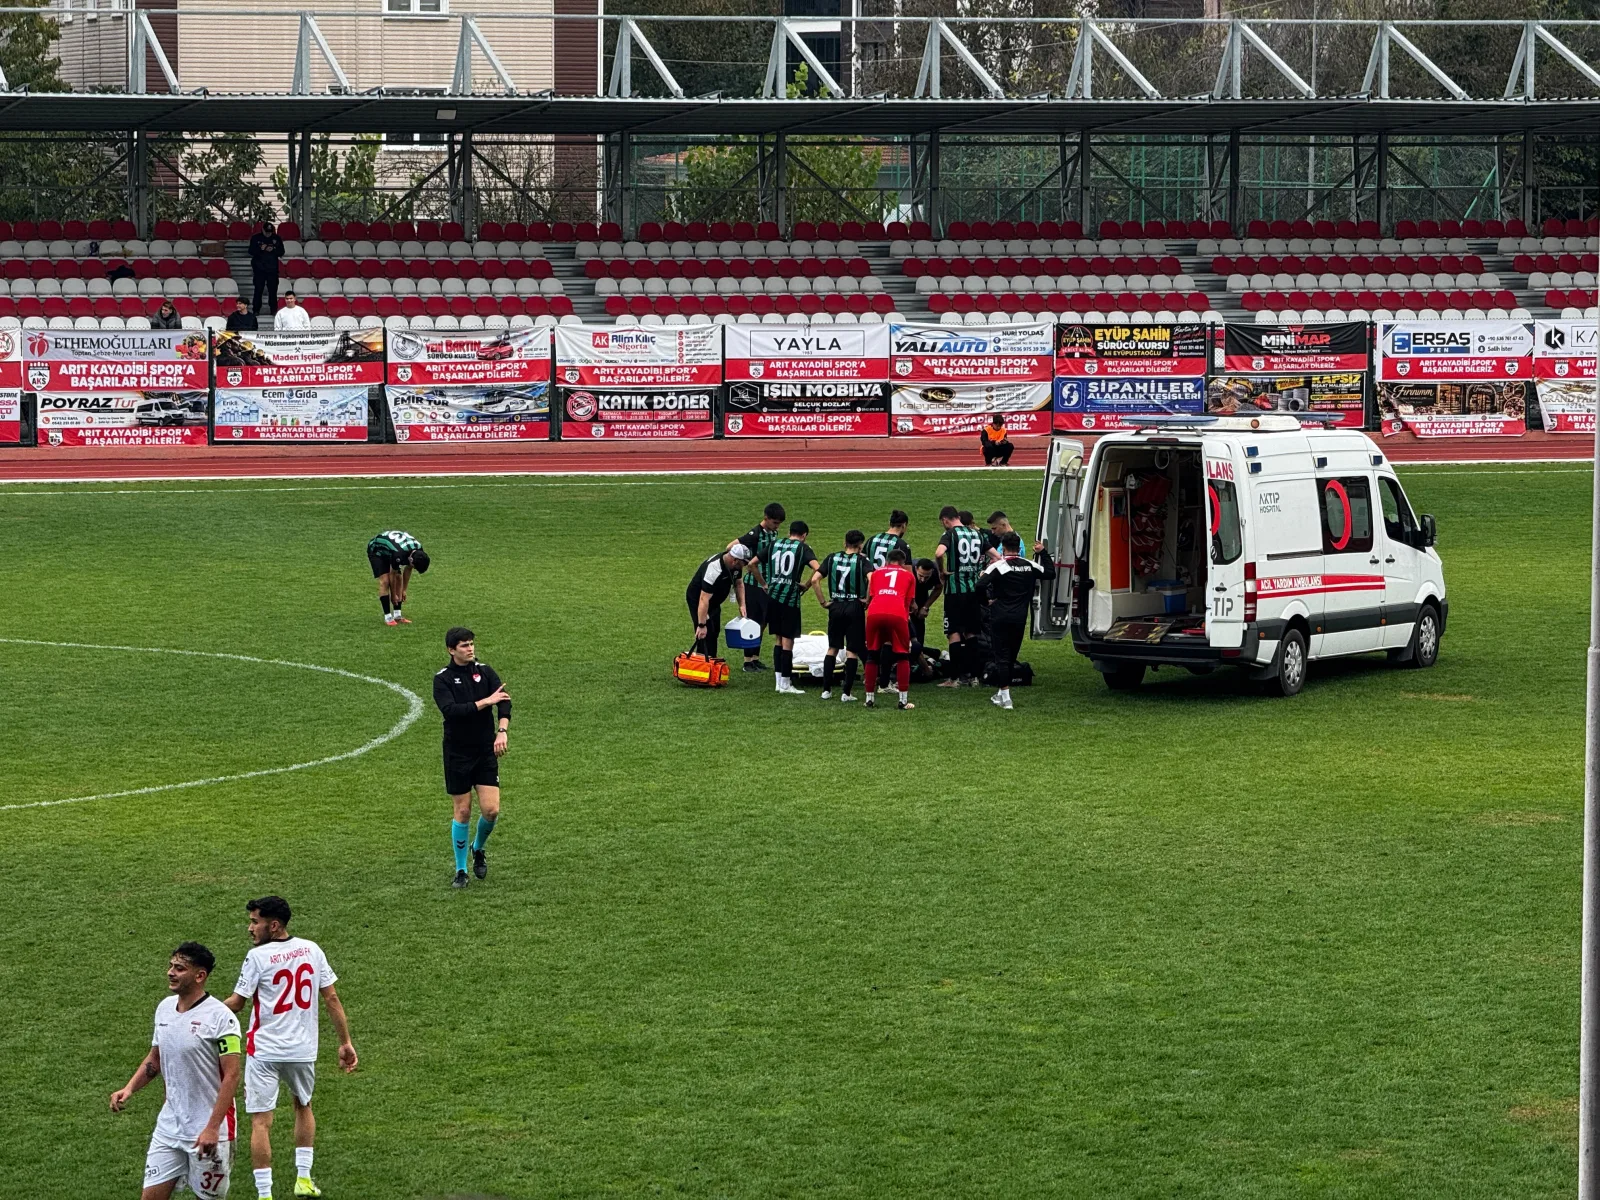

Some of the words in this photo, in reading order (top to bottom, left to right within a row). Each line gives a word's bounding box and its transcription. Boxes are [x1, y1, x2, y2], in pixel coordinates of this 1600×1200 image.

[279, 332, 310, 340] Taşkömürü
[594, 335, 608, 346] AK
[635, 334, 656, 345] Kılıç
[1095, 326, 1130, 341] EYÜP
[1133, 325, 1170, 343] ŞAHİN
[1412, 333, 1470, 347] ERSAŞ
[54, 335, 172, 350] ETHEMOĞULLARI
[264, 339, 298, 347] Müessesesi
[773, 337, 842, 351] YAYLA
[895, 341, 938, 353] YALI
[938, 341, 988, 353] AUTO
[1097, 340, 1136, 350] SÜRÜCÜ
[1138, 342, 1170, 350] KURSU
[301, 352, 326, 361] İşçileri
[923, 359, 947, 367] ARIT
[949, 357, 998, 366] KAYADİBİ
[1438, 358, 1471, 366] KAYADİBİ
[59, 364, 88, 375] ARIT
[90, 362, 148, 375] KAYADİBİ
[150, 364, 195, 375] SPOR'A
[255, 367, 279, 376] ARIT
[280, 364, 325, 375] KAYADİBİ
[425, 364, 447, 372] ARIT
[448, 362, 493, 371] KAYADİBİ
[617, 365, 662, 375] KAYADİBİ
[769, 361, 789, 369] ARIT
[791, 359, 833, 369] KAYADİBİ
[1422, 366, 1465, 374] BAŞARILAR
[1467, 365, 1495, 373] DİLERİZ.
[263, 375, 316, 384] BAŞARILAR
[319, 371, 357, 381] DİLERİZ.
[432, 372, 485, 382] BAŞARILAR
[486, 370, 523, 379] DİLERİZ.
[776, 369, 824, 379] BAŞARILAR
[826, 368, 861, 377] DİLERİZ.
[933, 367, 990, 377] BAŞARILAR
[993, 366, 1032, 375] DİLERİZ.
[71, 376, 137, 390] BAŞARILAR
[140, 374, 188, 387] DİLERİZ.
[600, 375, 655, 384] BAŞARILAR
[656, 373, 694, 382] DİLERİZ.
[763, 384, 801, 399] IŞIN
[1088, 380, 1195, 393] SİPAHİLER
[262, 389, 289, 399] Ecem
[295, 389, 318, 399] Gıda
[1148, 391, 1201, 400] TESİSLERİ
[40, 397, 114, 409] POYRAZ
[393, 395, 424, 406] EMİR
[598, 395, 648, 410] KATIK
[653, 392, 710, 410] DÖNER
[781, 414, 825, 423] KAYADİBİ
[923, 418, 947, 426] ARIT
[78, 429, 102, 437] ARIT
[104, 427, 152, 437] KAYADİBİ
[447, 423, 491, 432] KAYADİBİ
[768, 425, 818, 433] BAŞARILAR
[819, 423, 855, 432] DİLERİZ.
[85, 437, 141, 446] BAŞARILAR
[145, 436, 185, 445] DİLERİZ.
[431, 433, 484, 441] BAŞARILAR
[957, 538, 981, 564] 95
[771, 550, 796, 576] 10
[873, 545, 888, 570] 5
[836, 565, 851, 591] 7
[884, 570, 898, 588] 1
[1273, 576, 1294, 590] YARDIM
[878, 588, 898, 596] EREN
[269, 953, 282, 965] ARIT
[272, 962, 315, 1015] 26
[217, 1038, 228, 1054] C
[200, 1171, 225, 1192] 37
